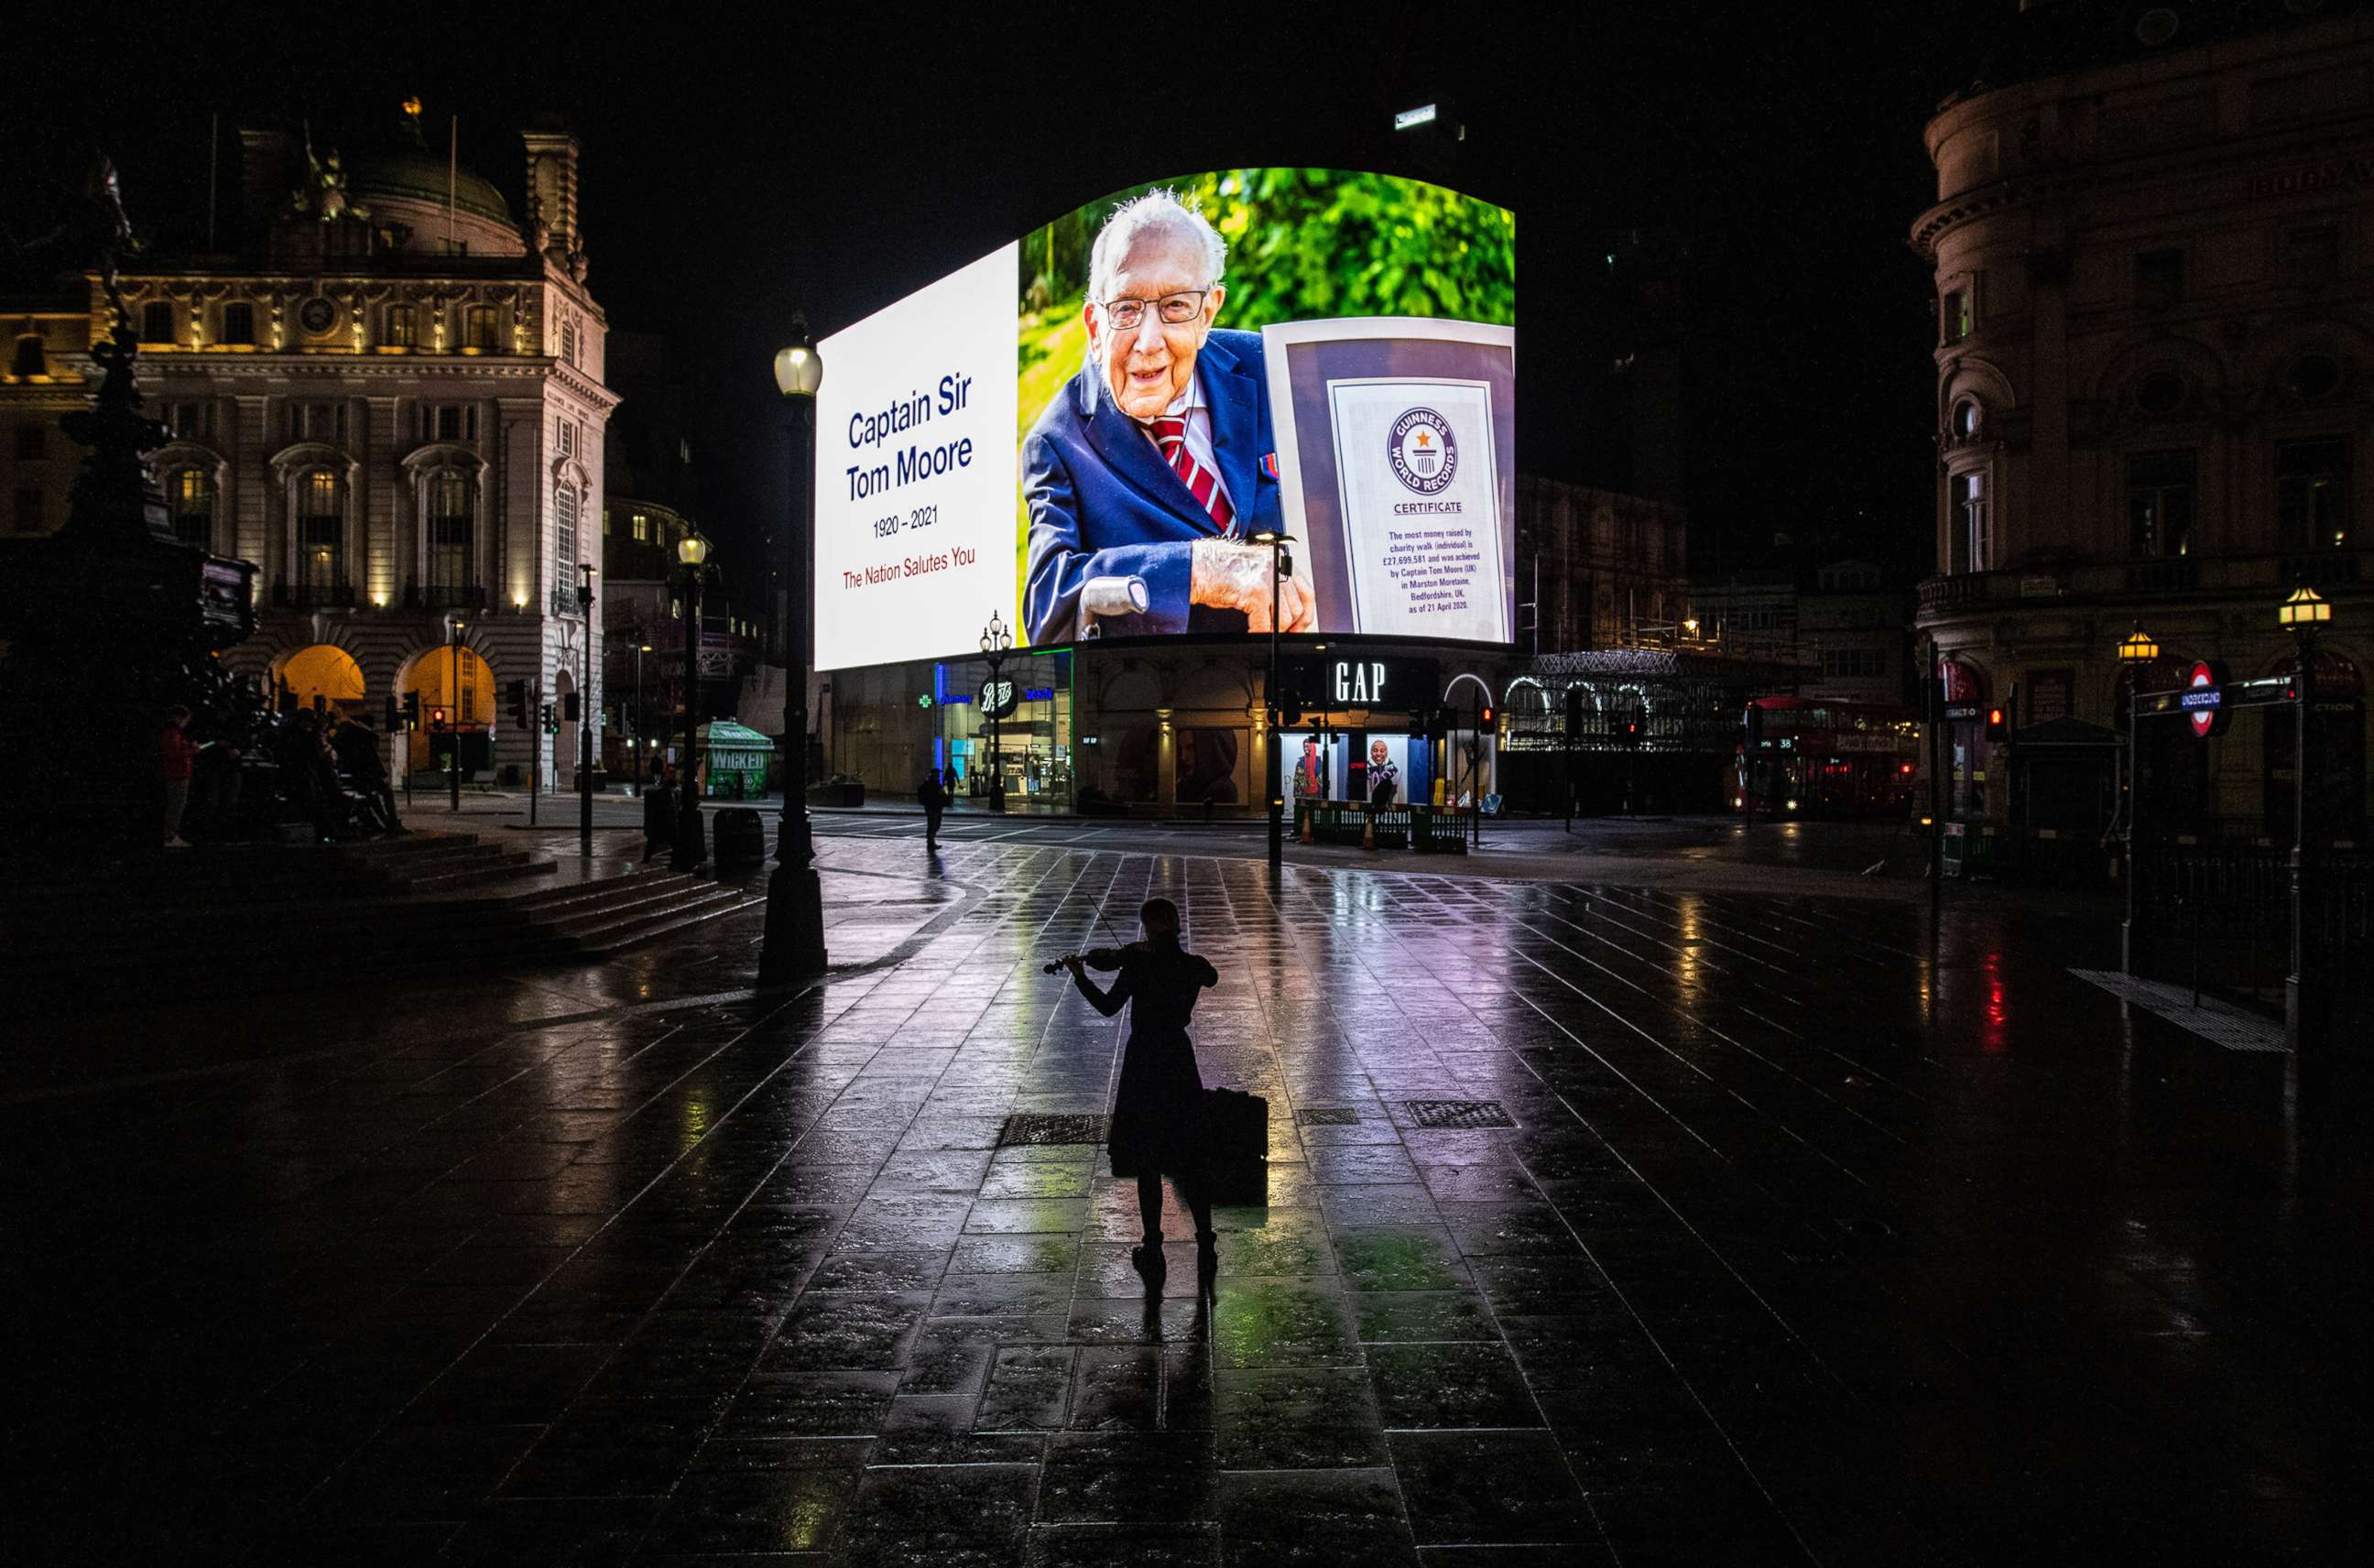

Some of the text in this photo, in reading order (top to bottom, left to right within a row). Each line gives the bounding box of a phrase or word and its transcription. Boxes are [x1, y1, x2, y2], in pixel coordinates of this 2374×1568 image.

[849, 372, 972, 449] Captain Sir
[1396, 412, 1448, 436] GUINNESS
[846, 437, 973, 501] Tom Moore
[1391, 446, 1454, 491] WORLD RECORDS
[1394, 502, 1462, 514] CERTIFICATE
[873, 515, 898, 539] 1920
[910, 505, 938, 529] 2021
[1388, 528, 1472, 540] The most money raised by
[1389, 543, 1414, 553] charity
[1416, 542, 1432, 550] walk
[1467, 540, 1473, 549] is
[1428, 554, 1440, 563] and
[1455, 552, 1480, 561] achieved
[844, 546, 975, 590] The Nation Salutes You
[1390, 564, 1477, 579] by Captain Tom Moore (UK)
[1401, 582, 1408, 590] in
[1410, 580, 1438, 589] Marston
[1419, 604, 1426, 613] of
[1427, 604, 1435, 613] 21
[1437, 603, 1452, 613] April
[1335, 661, 1386, 702] GAP
[980, 681, 1012, 713] Bts
[1780, 738, 1792, 748] 38
